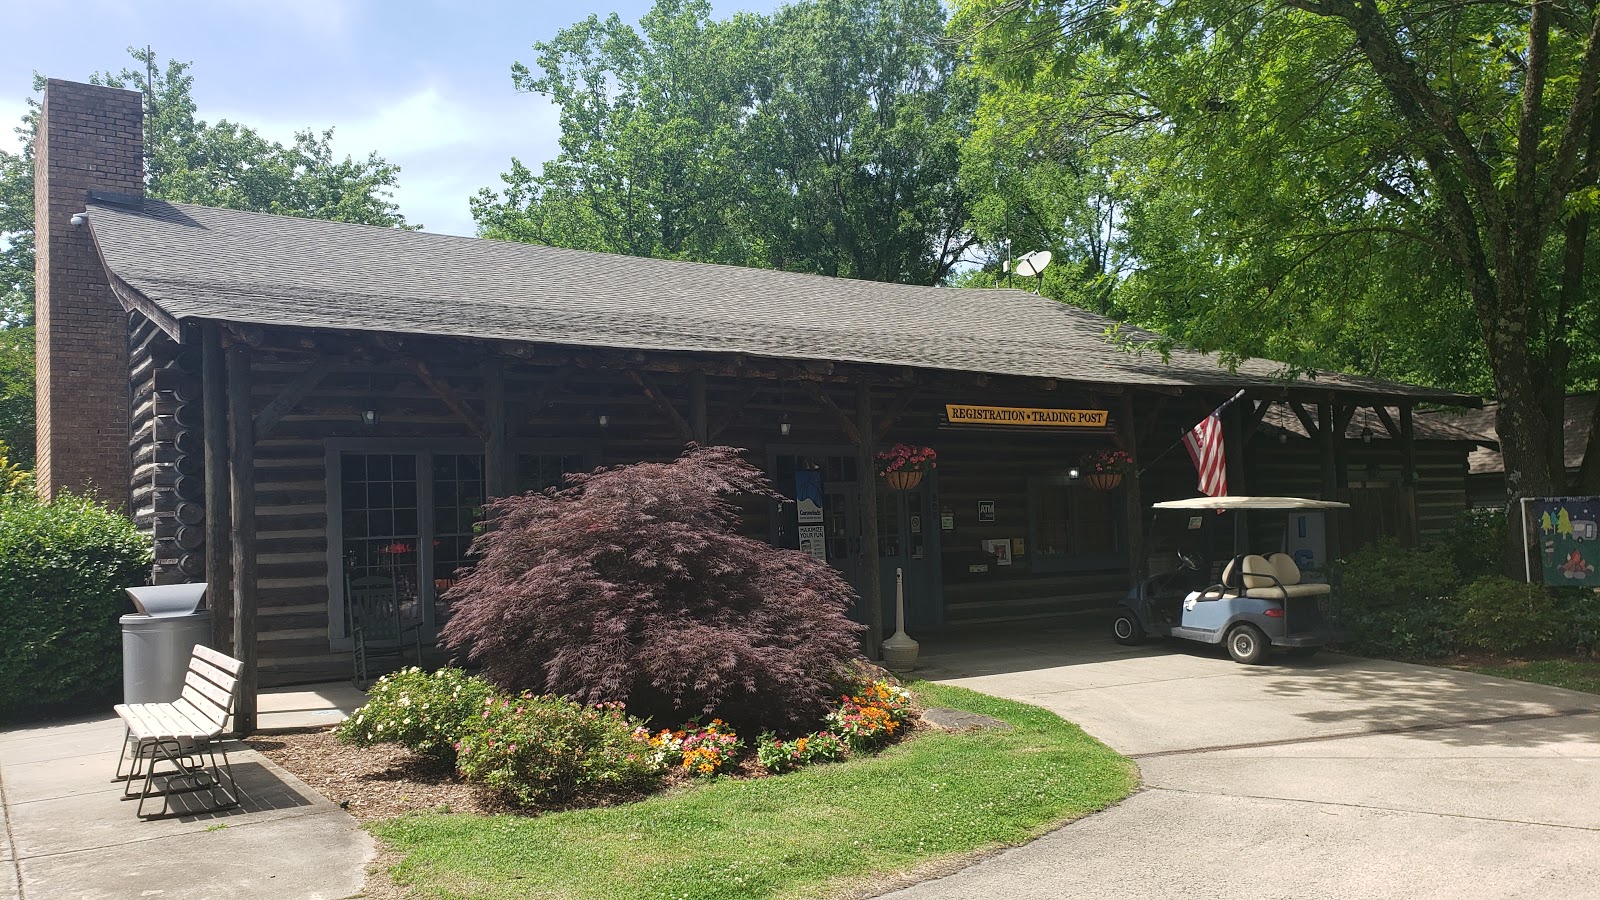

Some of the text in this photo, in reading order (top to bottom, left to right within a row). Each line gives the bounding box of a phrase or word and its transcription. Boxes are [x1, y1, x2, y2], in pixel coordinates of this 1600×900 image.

[952, 408, 1103, 423] REGISTRATION TRADING POST
[981, 504, 994, 513] ATM
